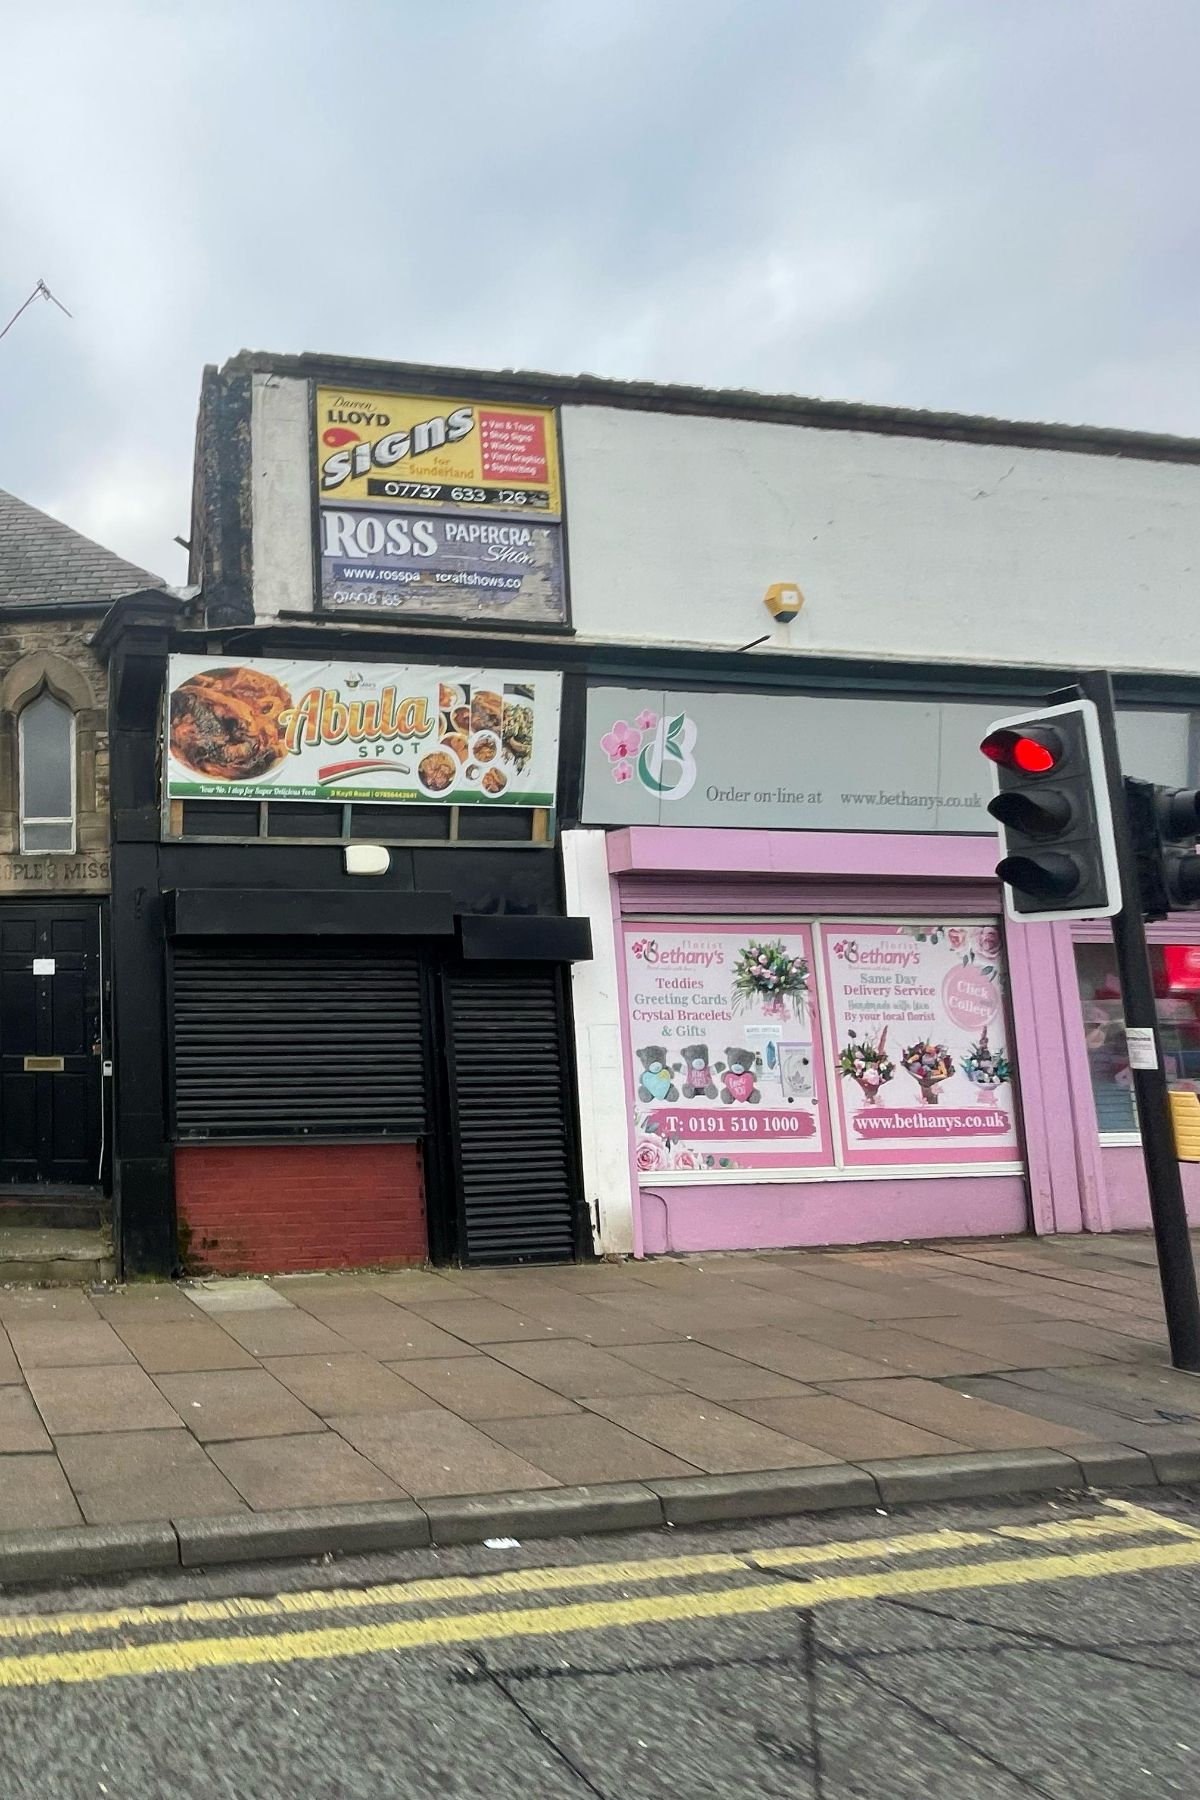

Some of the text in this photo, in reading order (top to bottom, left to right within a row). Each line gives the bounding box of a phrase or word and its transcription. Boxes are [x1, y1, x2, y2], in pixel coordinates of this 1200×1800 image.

[333, 397, 377, 410] Darren
[328, 410, 390, 426] LLOYD
[409, 465, 475, 479] Sunderland
[385, 482, 441, 499] 07737
[451, 487, 486, 502] 633
[445, 523, 550, 546] PAPERCRA
[278, 685, 435, 755] Abula
[359, 742, 421, 758] SPOT
[706, 785, 982, 809] Order on-line at www.bethanys.co.uk
[682, 940, 723, 949] florist
[644, 941, 724, 968] Bethany's
[844, 941, 920, 968] Bethany's
[655, 977, 704, 989] Teddies
[860, 973, 917, 986] Same Day
[843, 985, 935, 997] Delivery Service
[957, 981, 988, 999] Click
[634, 994, 728, 1006] Greeting Cards
[632, 1009, 732, 1022] Crystal Bracelets
[844, 1011, 935, 1022] By your local florist
[661, 1025, 706, 1037] & Gifts
[666, 1116, 799, 1132] T: 0191 510 1000
[856, 1112, 1004, 1131] www.bethanys.co.uk
